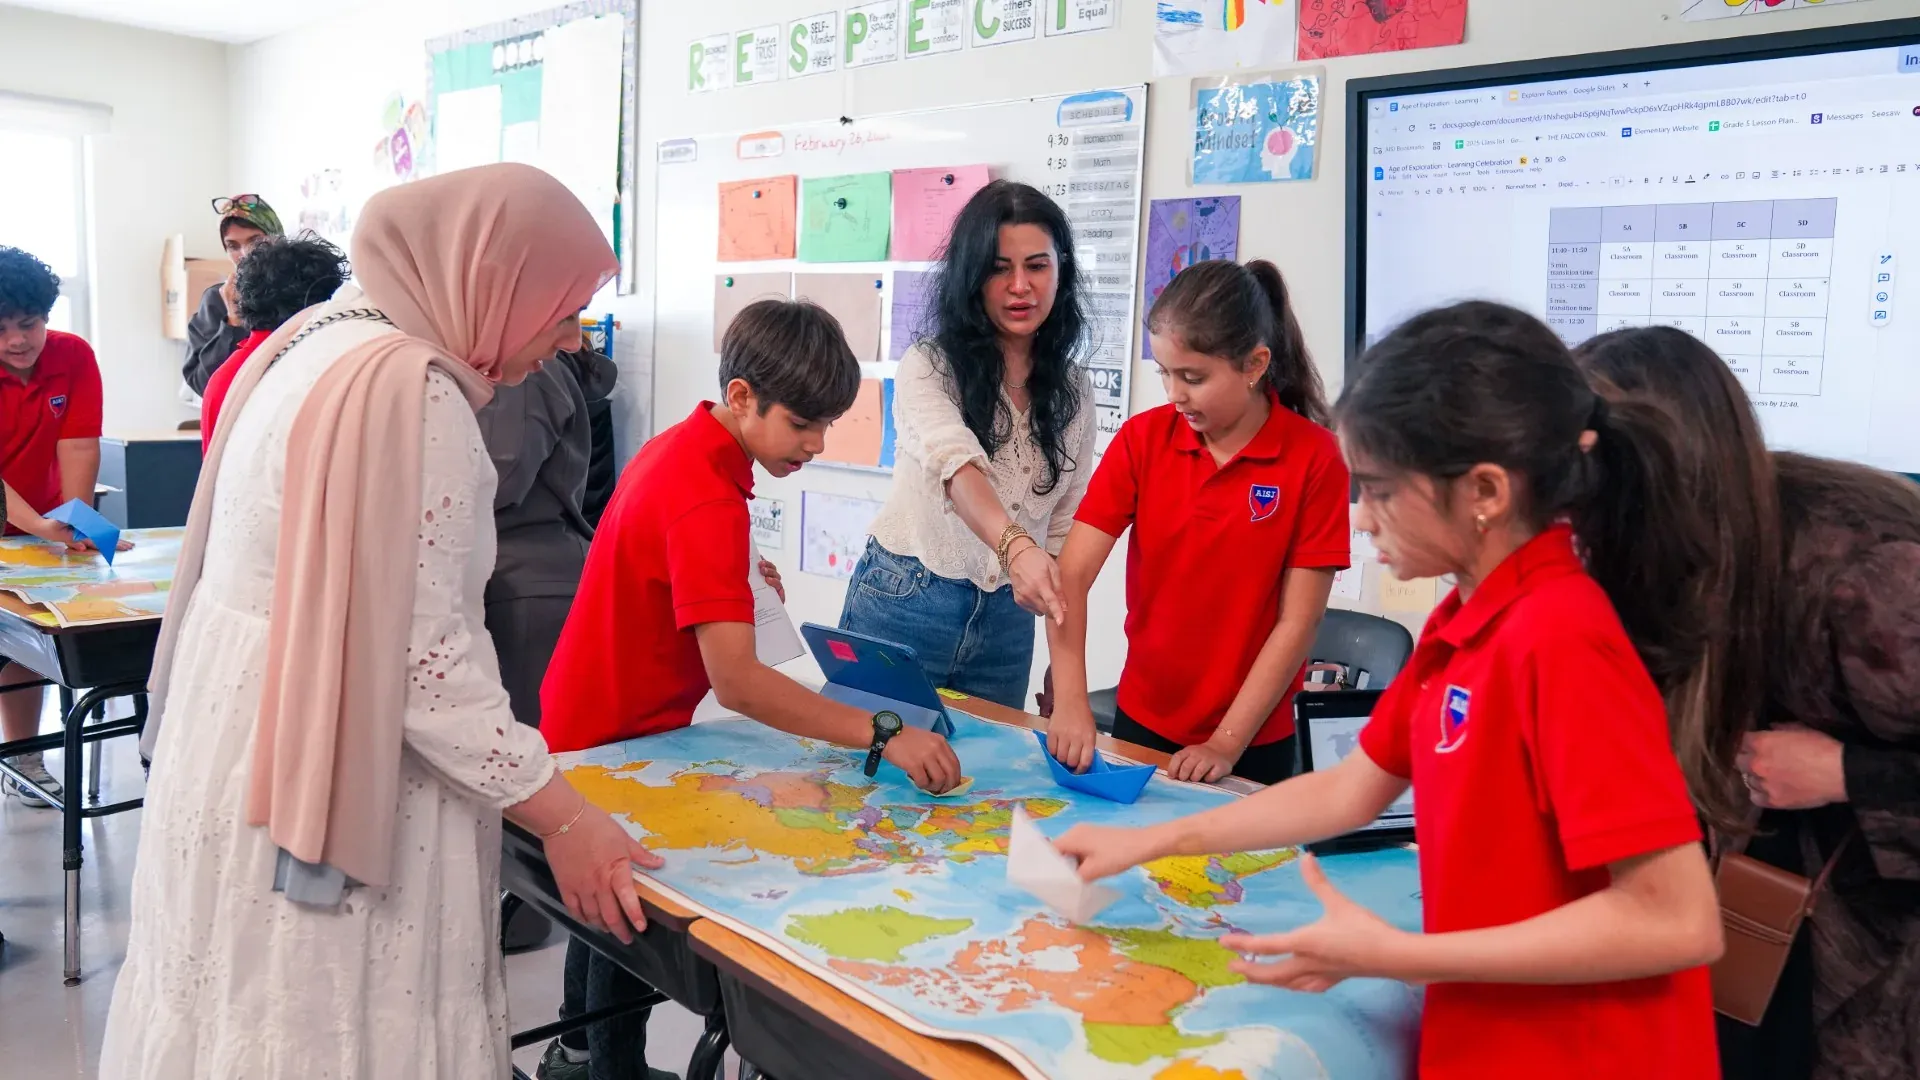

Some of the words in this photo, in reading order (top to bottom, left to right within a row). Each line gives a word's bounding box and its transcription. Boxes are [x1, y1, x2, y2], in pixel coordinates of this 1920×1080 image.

[1003, 0, 1032, 11] others
[1078, 4, 1108, 21] Equal
[1003, 17, 1032, 32] SUCCESS
[1905, 54, 1920, 66] In
[1573, 87, 1596, 95] Google
[1597, 84, 1616, 92] Slides
[1069, 107, 1119, 120] SCHEDULE
[1826, 111, 1864, 123] Messages
[1871, 110, 1901, 118] Seesaw
[1722, 120, 1744, 129] Grade
[1752, 119, 1777, 127] Lesson
[1634, 126, 1670, 135] Elementary
[1672, 124, 1699, 132] Website
[1047, 133, 1069, 148] 9:30
[1083, 133, 1124, 144] Homeroom
[1195, 129, 1257, 152] Mindset
[1548, 134, 1559, 142] THE
[1561, 132, 1586, 140] FALCON
[794, 134, 845, 155] February
[1047, 157, 1067, 170] 9:50
[1093, 158, 1112, 168] Math
[1389, 165, 1400, 173] Age
[1409, 163, 1443, 172] Exploration
[1448, 161, 1475, 169] Learning
[1476, 159, 1513, 167] Celebration
[1070, 181, 1130, 192] RECESS/TAG
[1797, 219, 1808, 227] 5D
[1796, 242, 1806, 250] 5D
[1722, 251, 1757, 259] Classroom
[1782, 250, 1819, 258] Classroom
[1793, 282, 1803, 290] 5A
[1608, 290, 1641, 298] Classroom
[1778, 290, 1816, 298] Classroom
[1790, 321, 1801, 329] 5B
[1716, 328, 1752, 336] Classroom
[1776, 329, 1813, 337] Classroom
[1773, 367, 1810, 375] Classroom
[1255, 489, 1276, 498] AISJ
